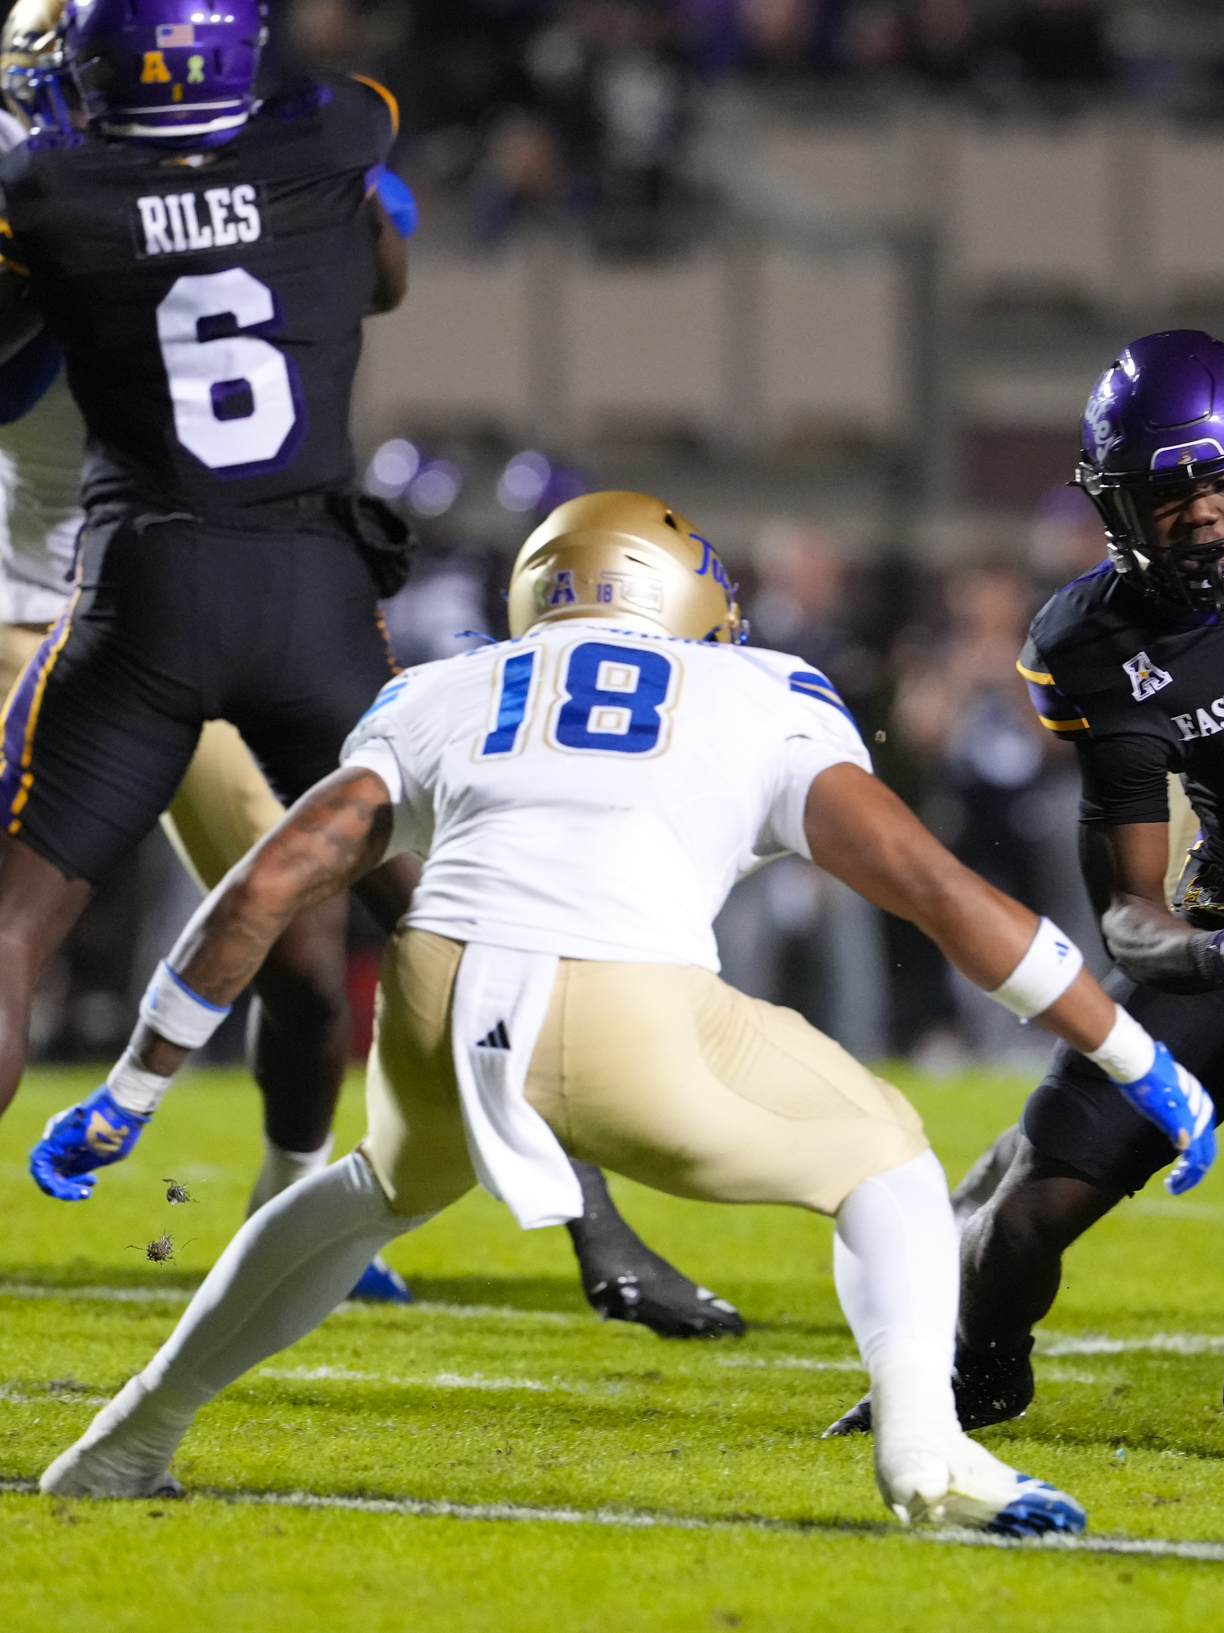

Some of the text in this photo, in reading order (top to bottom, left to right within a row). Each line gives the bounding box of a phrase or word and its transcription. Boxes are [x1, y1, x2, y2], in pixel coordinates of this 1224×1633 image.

[137, 183, 262, 256] RILES
[156, 267, 297, 470] 6
[596, 583, 613, 604] 18
[480, 640, 674, 758] 18
